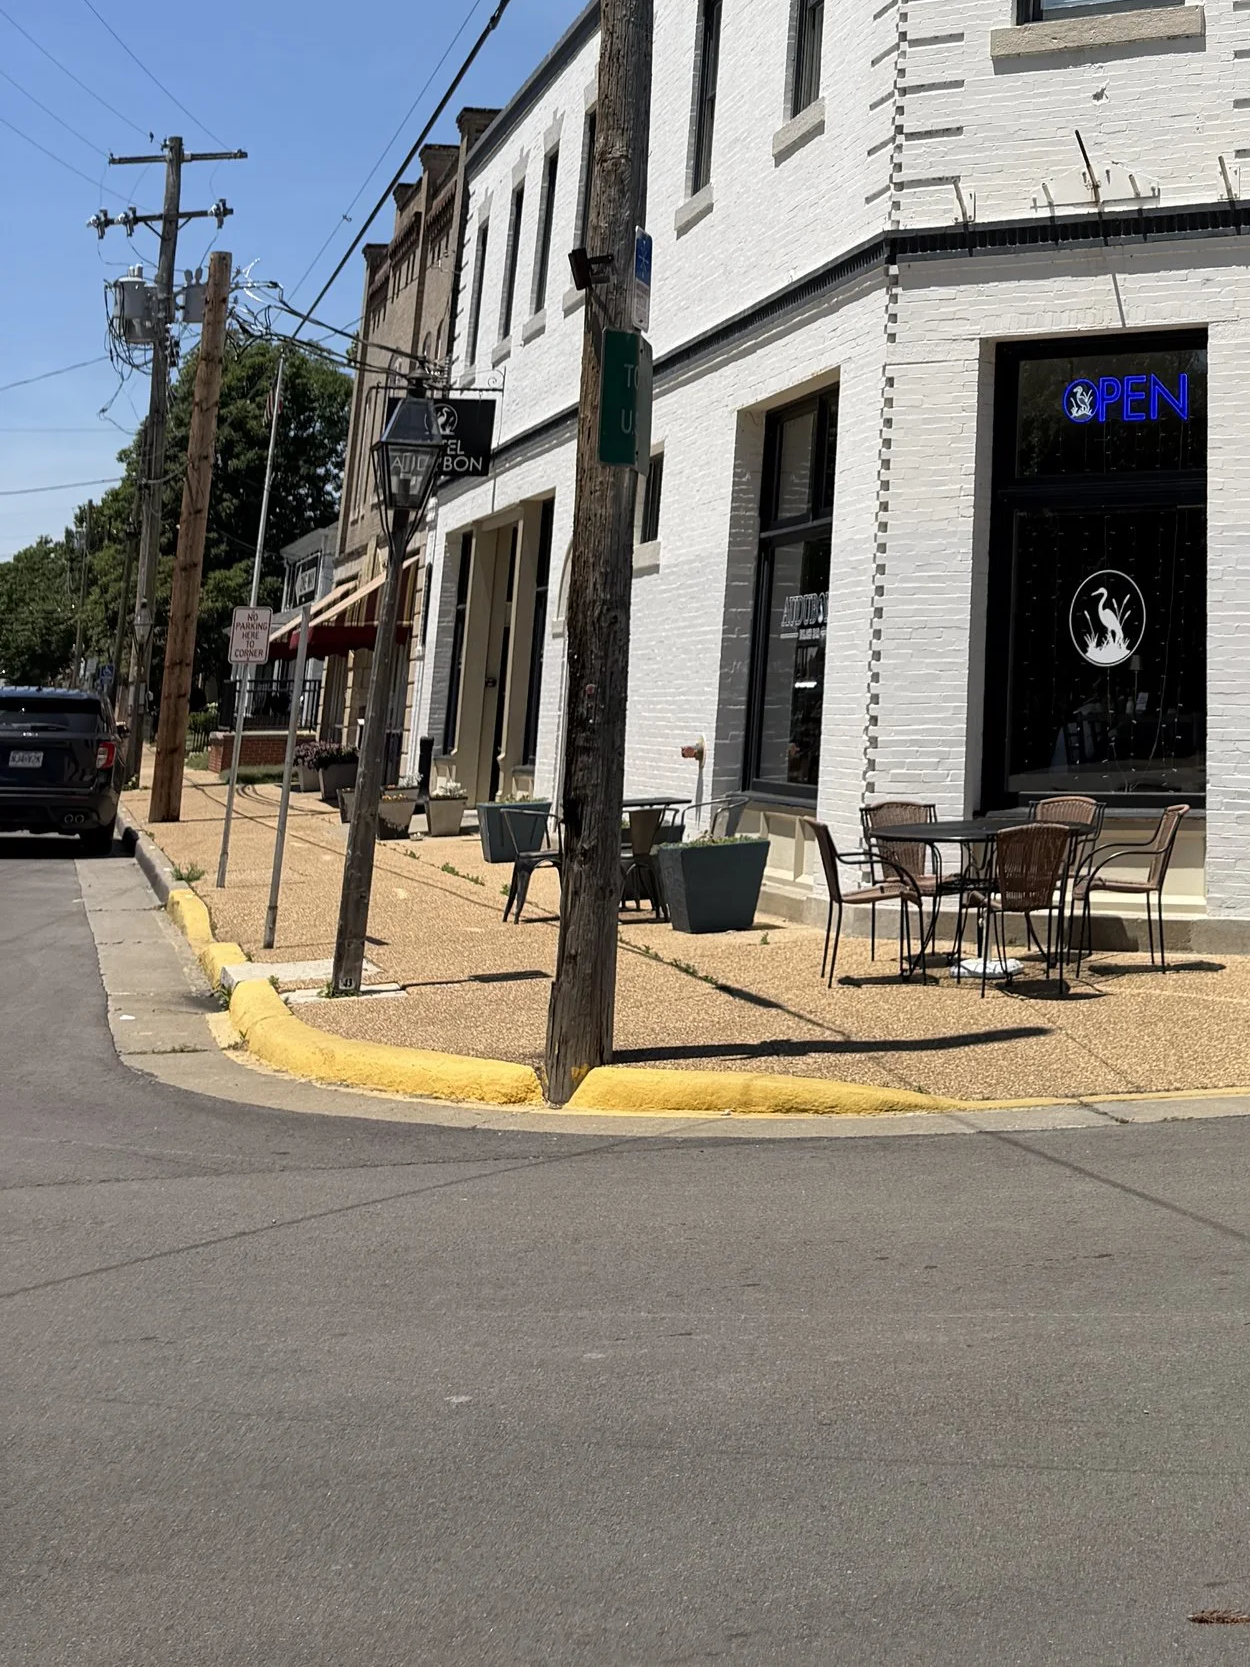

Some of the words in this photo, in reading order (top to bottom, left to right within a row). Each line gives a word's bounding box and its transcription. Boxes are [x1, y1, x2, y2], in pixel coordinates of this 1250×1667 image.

[1063, 373, 1188, 423] OPEN
[247, 613, 259, 622] NO
[235, 621, 268, 631] PARKING
[241, 631, 259, 640] HERE
[246, 639, 255, 649] TO
[234, 648, 264, 659] CORNER
